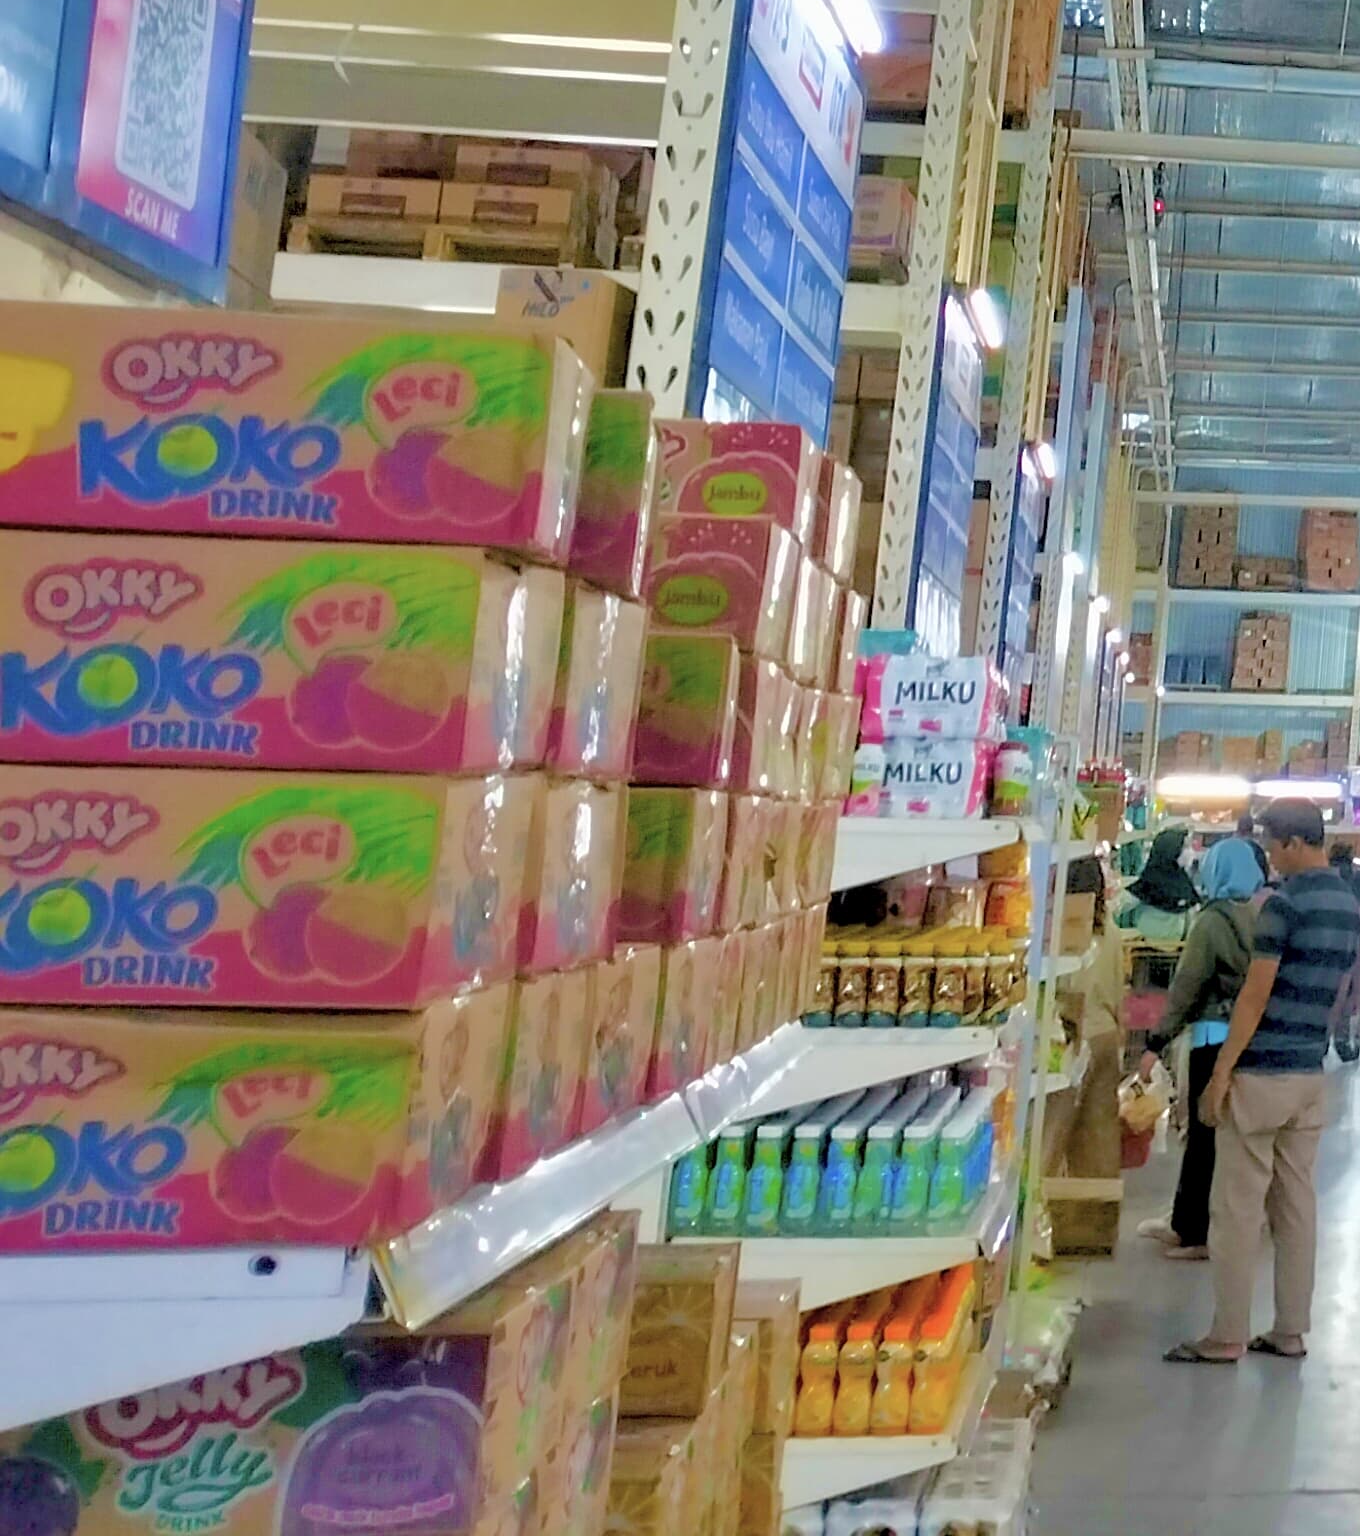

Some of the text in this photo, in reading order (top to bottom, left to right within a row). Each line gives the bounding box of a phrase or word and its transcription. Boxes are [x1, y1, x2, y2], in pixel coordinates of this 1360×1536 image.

[124, 186, 180, 241] SCAN ME
[112, 339, 278, 395] OKKY
[372, 370, 461, 425] Leci
[78, 412, 341, 504] KOKO
[209, 488, 341, 526] DRINK
[33, 566, 197, 623] OKKY
[293, 593, 384, 649] Leci
[0, 641, 264, 737] KOKO
[894, 678, 978, 705] MILKU
[129, 719, 262, 756] DRINK
[882, 761, 963, 787] MILKU
[251, 822, 342, 879] Leci
[0, 876, 220, 972] OKO
[81, 954, 217, 990] DRINK
[0, 1044, 122, 1090] KKY
[222, 1071, 313, 1120] Leci
[0, 1120, 188, 1218] OKO
[44, 1200, 181, 1238] DRINK
[631, 1358, 679, 1380] eruk
[117, 1431, 273, 1514] Jelly
